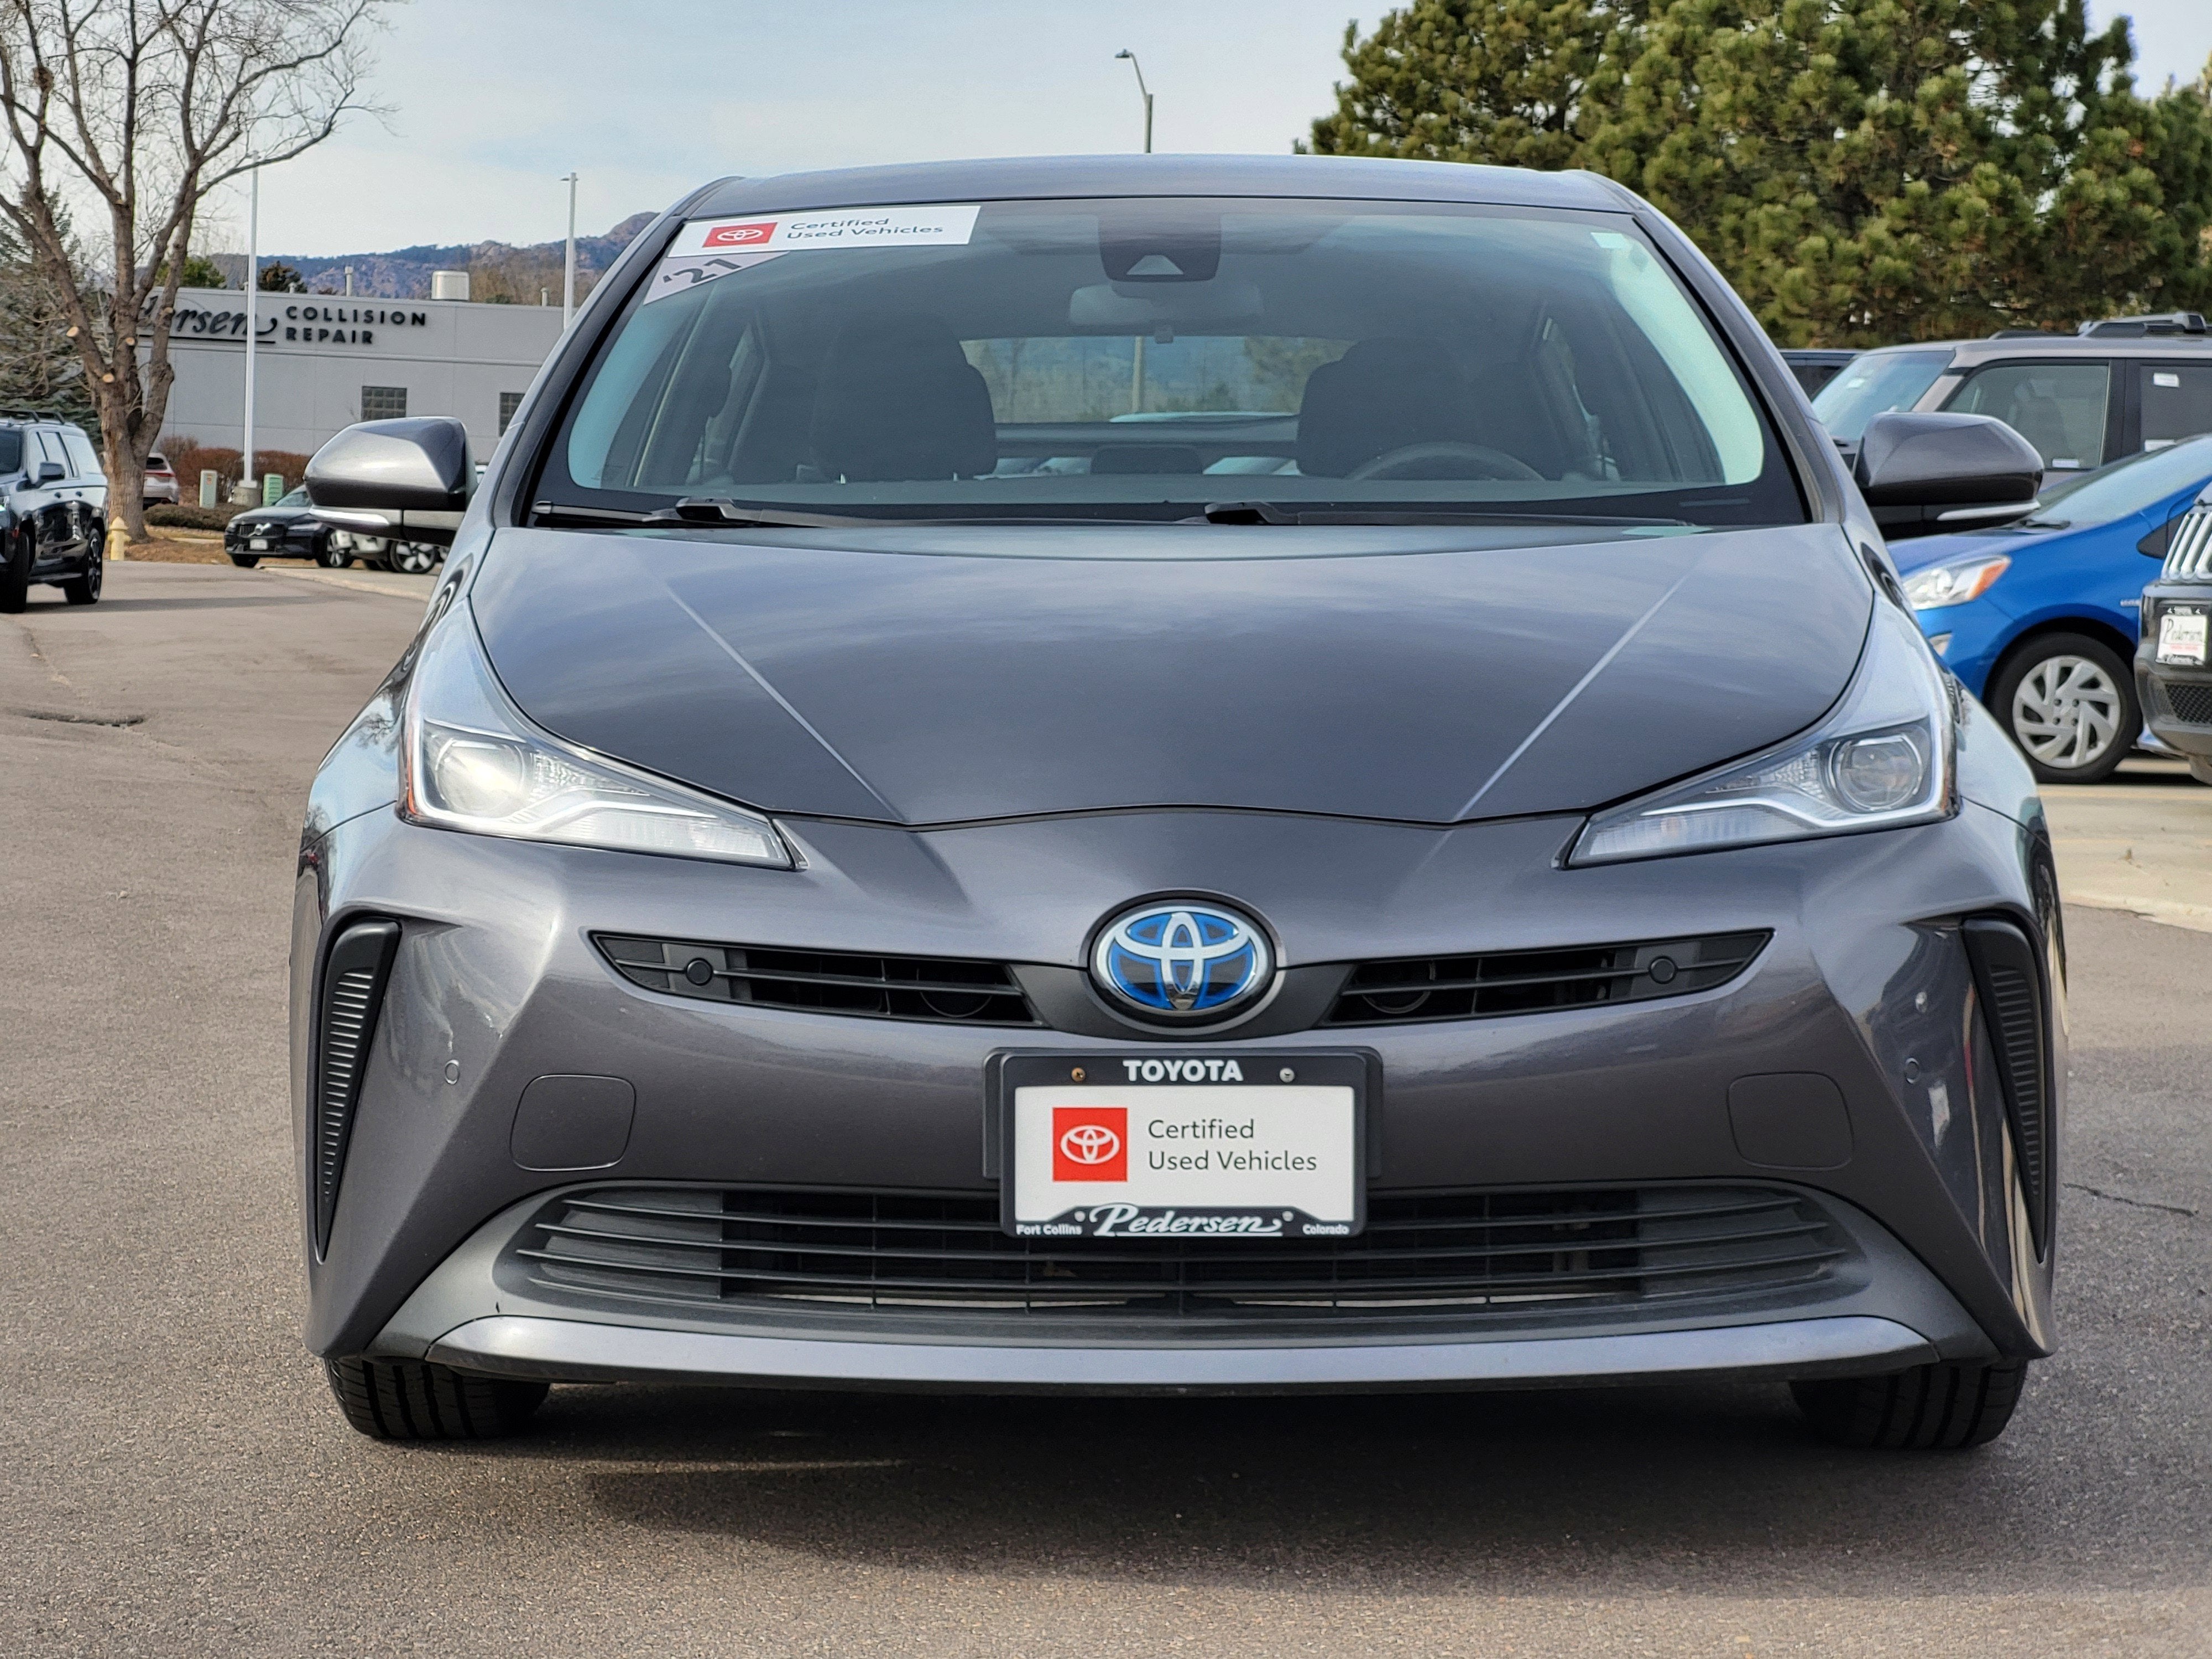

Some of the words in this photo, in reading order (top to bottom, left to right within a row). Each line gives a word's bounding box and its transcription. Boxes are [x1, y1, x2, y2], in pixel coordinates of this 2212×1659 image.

[787, 229, 843, 239] Used
[852, 226, 943, 236] Vehicles
[791, 218, 889, 229] Certified
[663, 258, 742, 283] '21
[286, 306, 426, 326] COLLISION
[286, 327, 373, 344] REPAIR
[1123, 1060, 1244, 1082] TOYOTA
[1149, 1118, 1254, 1139] Certified
[1149, 1150, 1209, 1170] Used
[1217, 1150, 1317, 1170] Vehicles
[1016, 1224, 1041, 1235] Fort
[1042, 1223, 1083, 1235] Collins
[1089, 1203, 1283, 1237] Pedersen
[1302, 1223, 1350, 1235] Colorado
